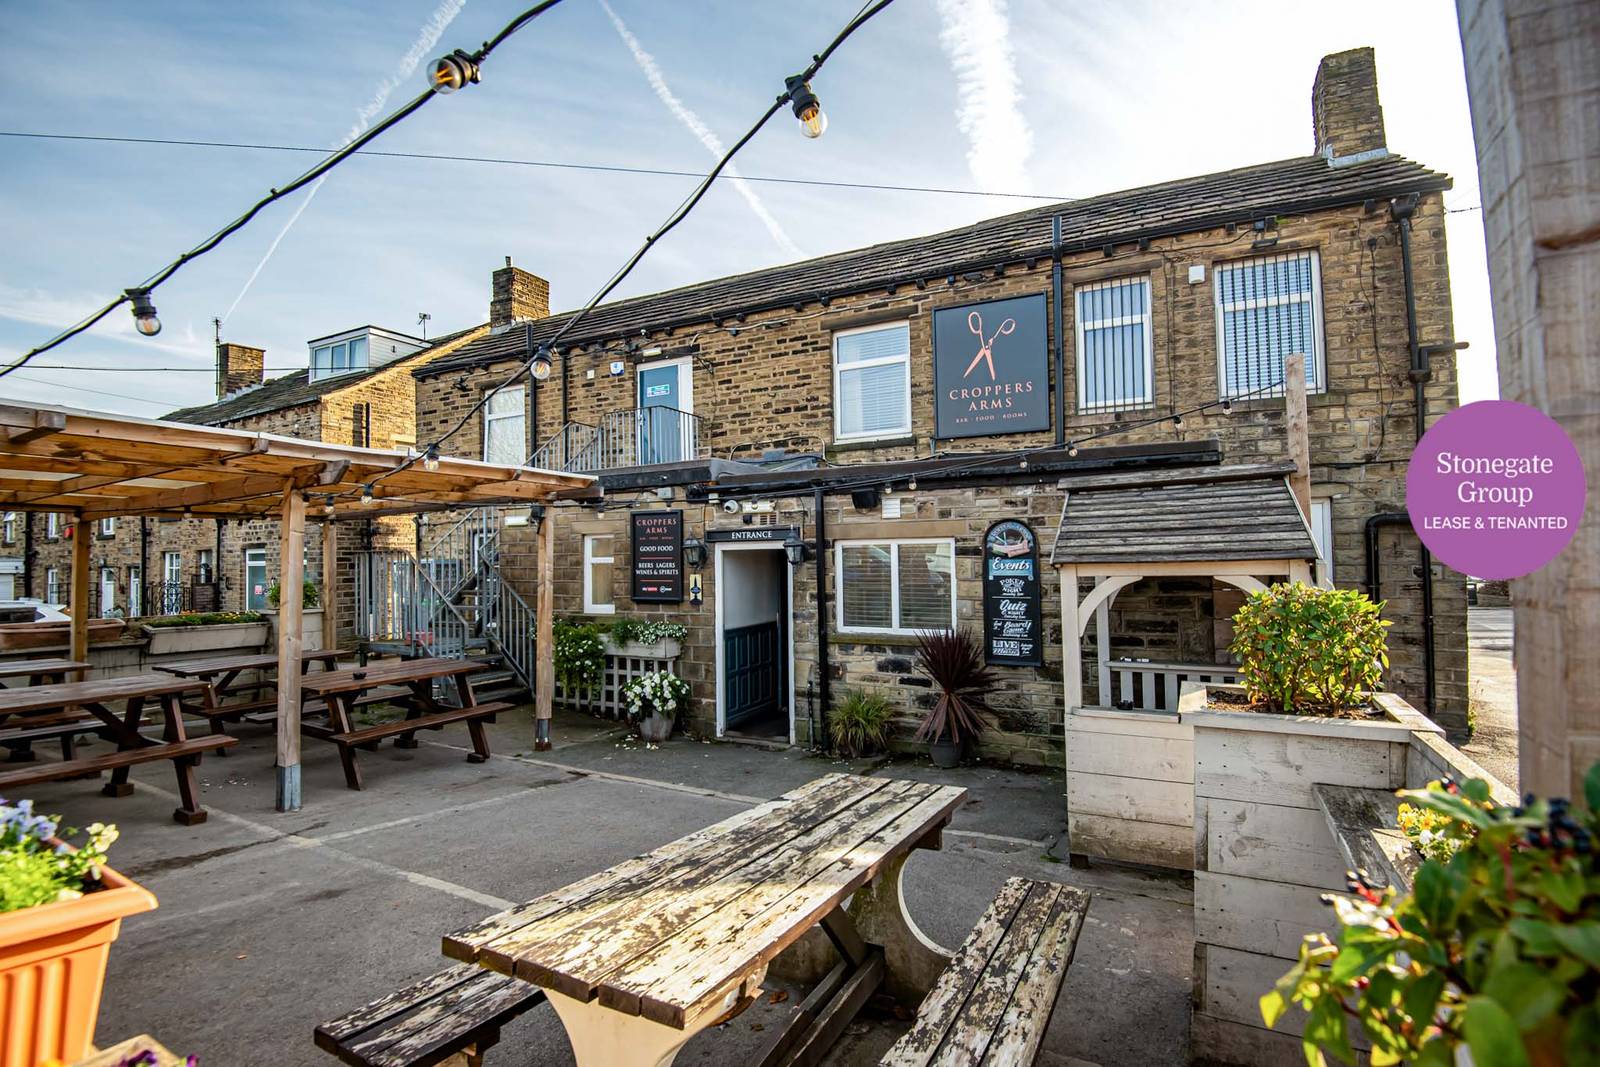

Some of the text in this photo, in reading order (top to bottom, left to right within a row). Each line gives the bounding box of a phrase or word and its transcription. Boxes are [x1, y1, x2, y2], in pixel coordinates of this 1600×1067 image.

[949, 381, 1032, 400] CROPPERS
[968, 397, 1012, 411] ARMS
[636, 518, 677, 526] CROPPERS
[731, 531, 772, 539] ENTRANCE
[992, 557, 1030, 570] Events
[1000, 600, 1027, 611] Quiz
